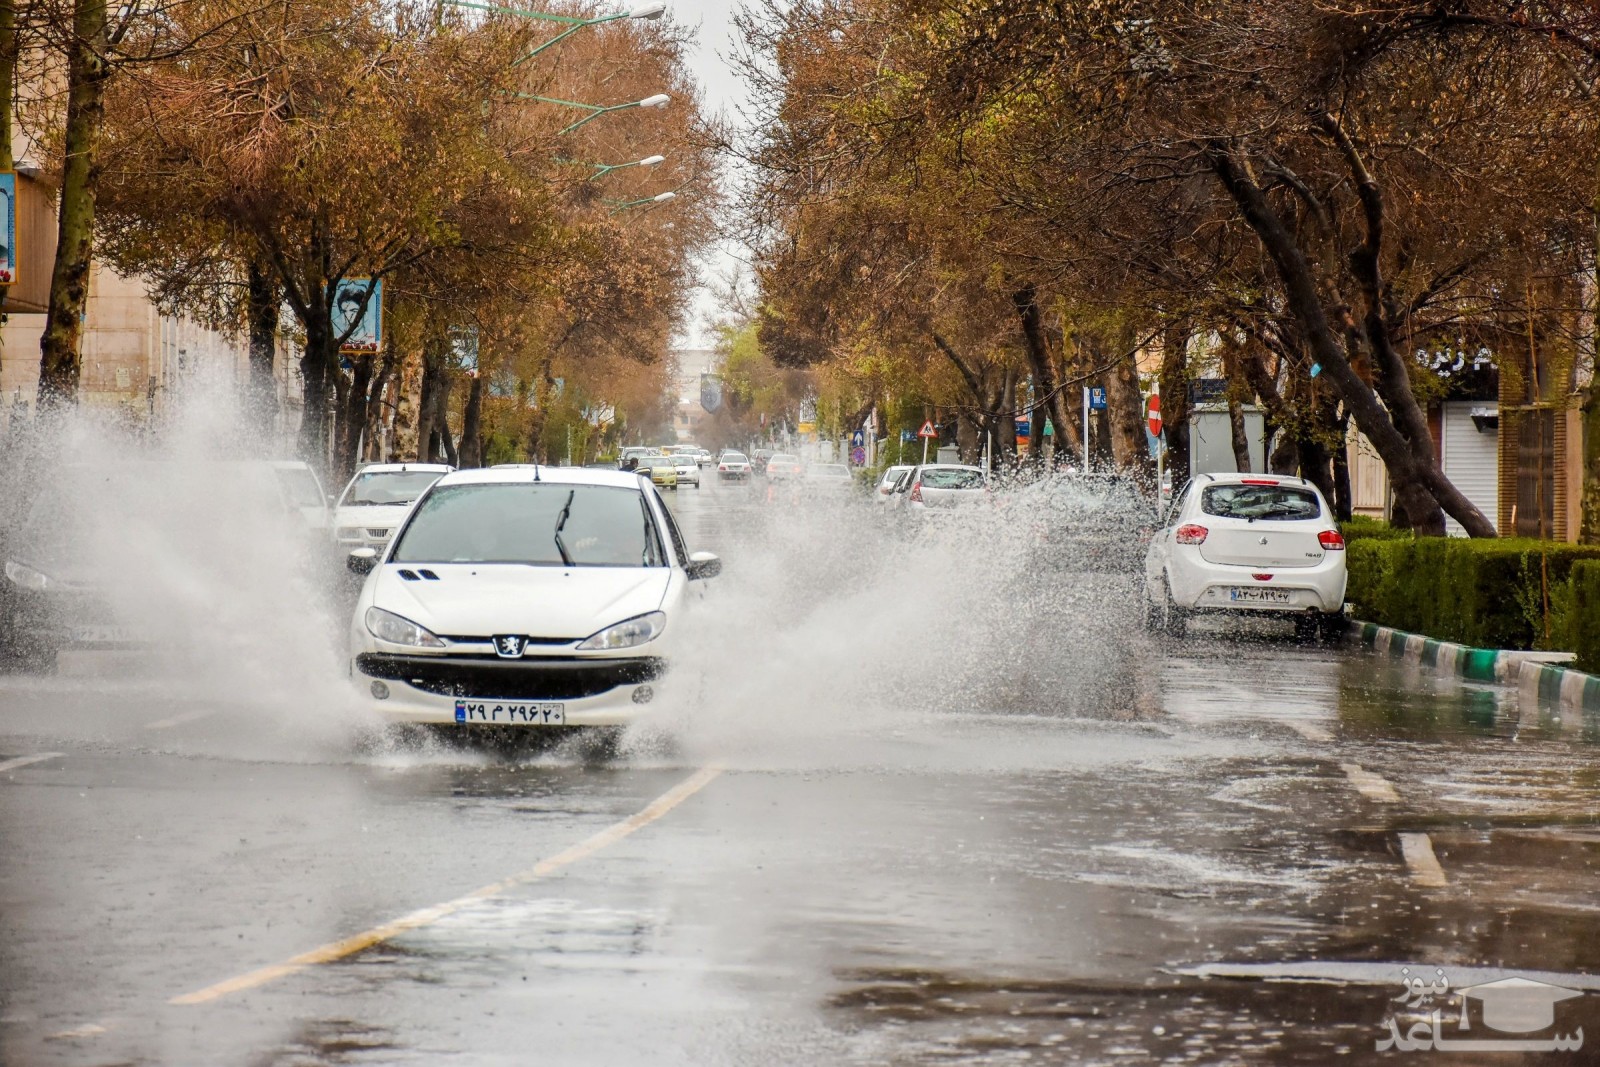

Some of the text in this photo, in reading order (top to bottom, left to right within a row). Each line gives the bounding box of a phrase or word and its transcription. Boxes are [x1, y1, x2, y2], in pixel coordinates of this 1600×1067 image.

[468, 704, 486, 720] ۲۹
[492, 705, 503, 720] م
[508, 706, 538, 721] ۲۹۶
[543, 709, 560, 722] ۲۰
